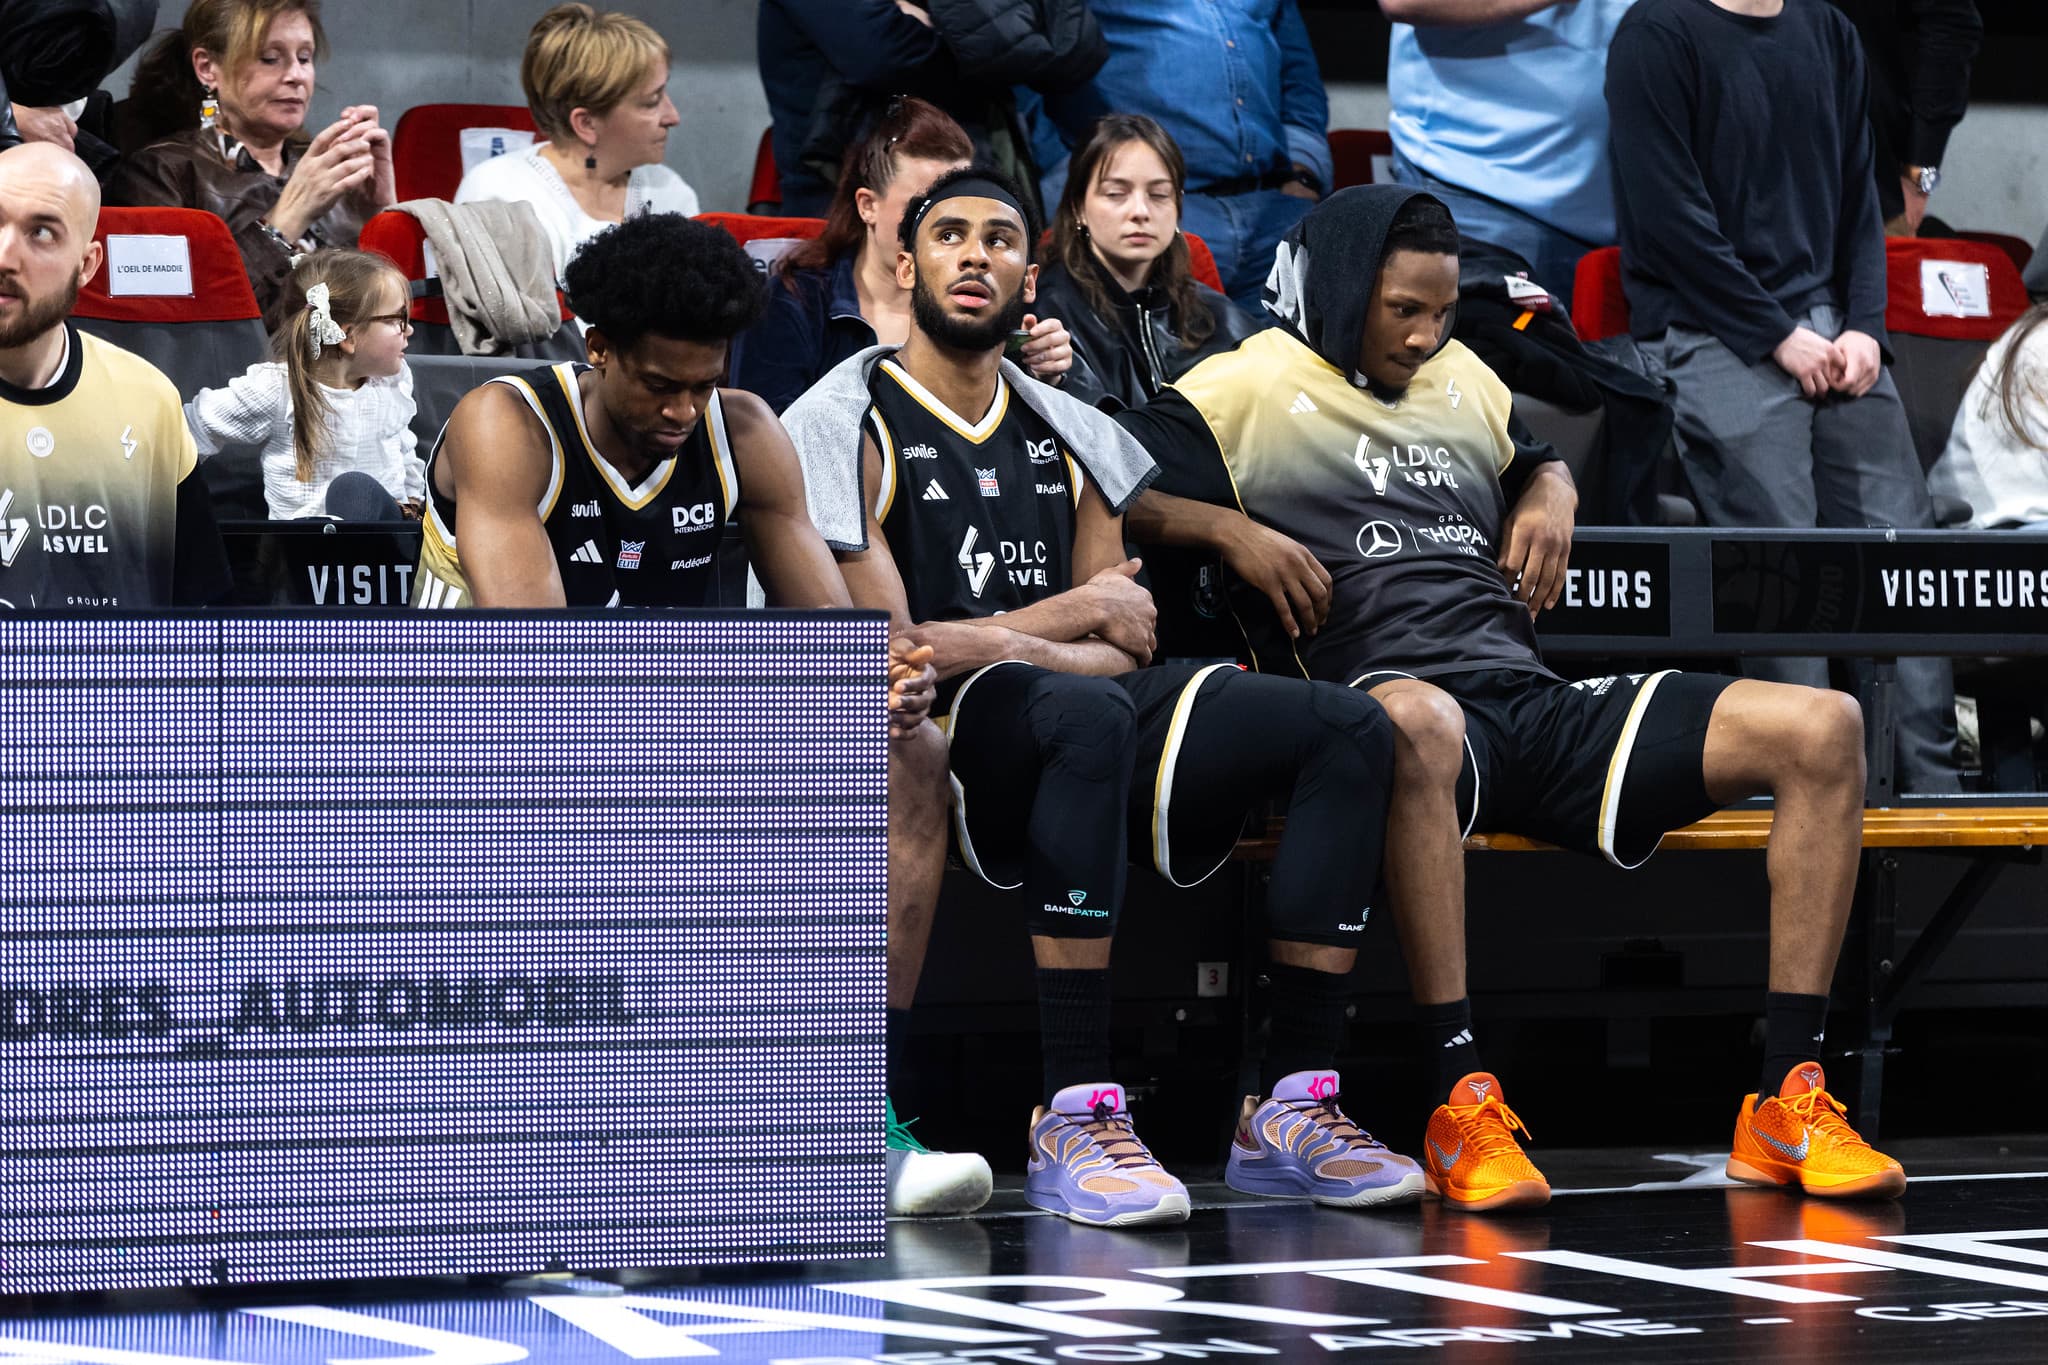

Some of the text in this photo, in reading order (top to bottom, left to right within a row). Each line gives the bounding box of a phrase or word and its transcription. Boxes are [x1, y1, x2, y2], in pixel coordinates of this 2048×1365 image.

[117, 264, 183, 273] L'OEIL DE MADDIE
[1025, 437, 1057, 459] DC
[1392, 444, 1451, 469] LDLC
[672, 502, 715, 527] DCB
[43, 535, 108, 553] ASVEL
[619, 559, 639, 568] ELITE
[307, 564, 413, 606] VISIT
[66, 596, 118, 607] GROUPE
[1044, 904, 1109, 918] GAMEPATCH
[1208, 969, 1219, 986] 3
[1308, 1317, 1703, 1352] ARME
